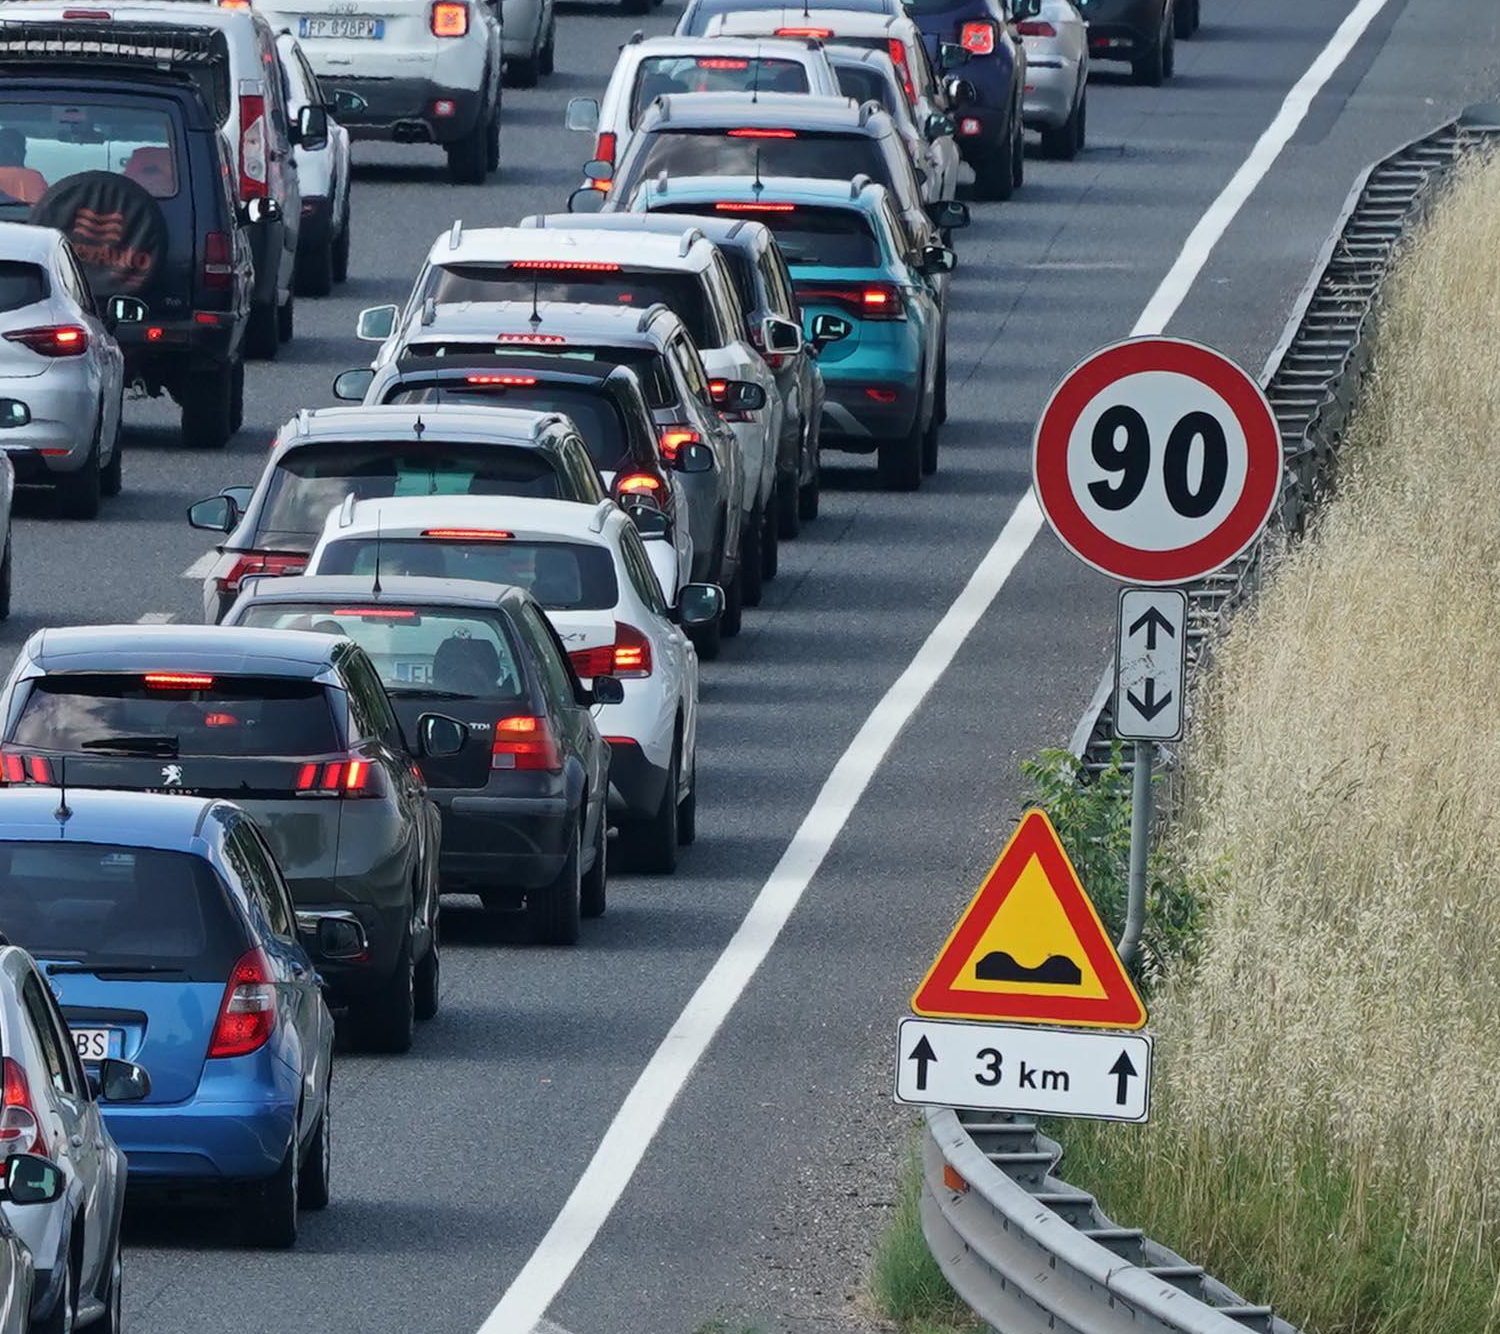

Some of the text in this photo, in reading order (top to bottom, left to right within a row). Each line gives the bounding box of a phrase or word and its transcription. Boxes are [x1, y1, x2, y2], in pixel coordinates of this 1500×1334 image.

[1086, 404, 1230, 519] 90
[974, 1047, 1070, 1092] 3 km
